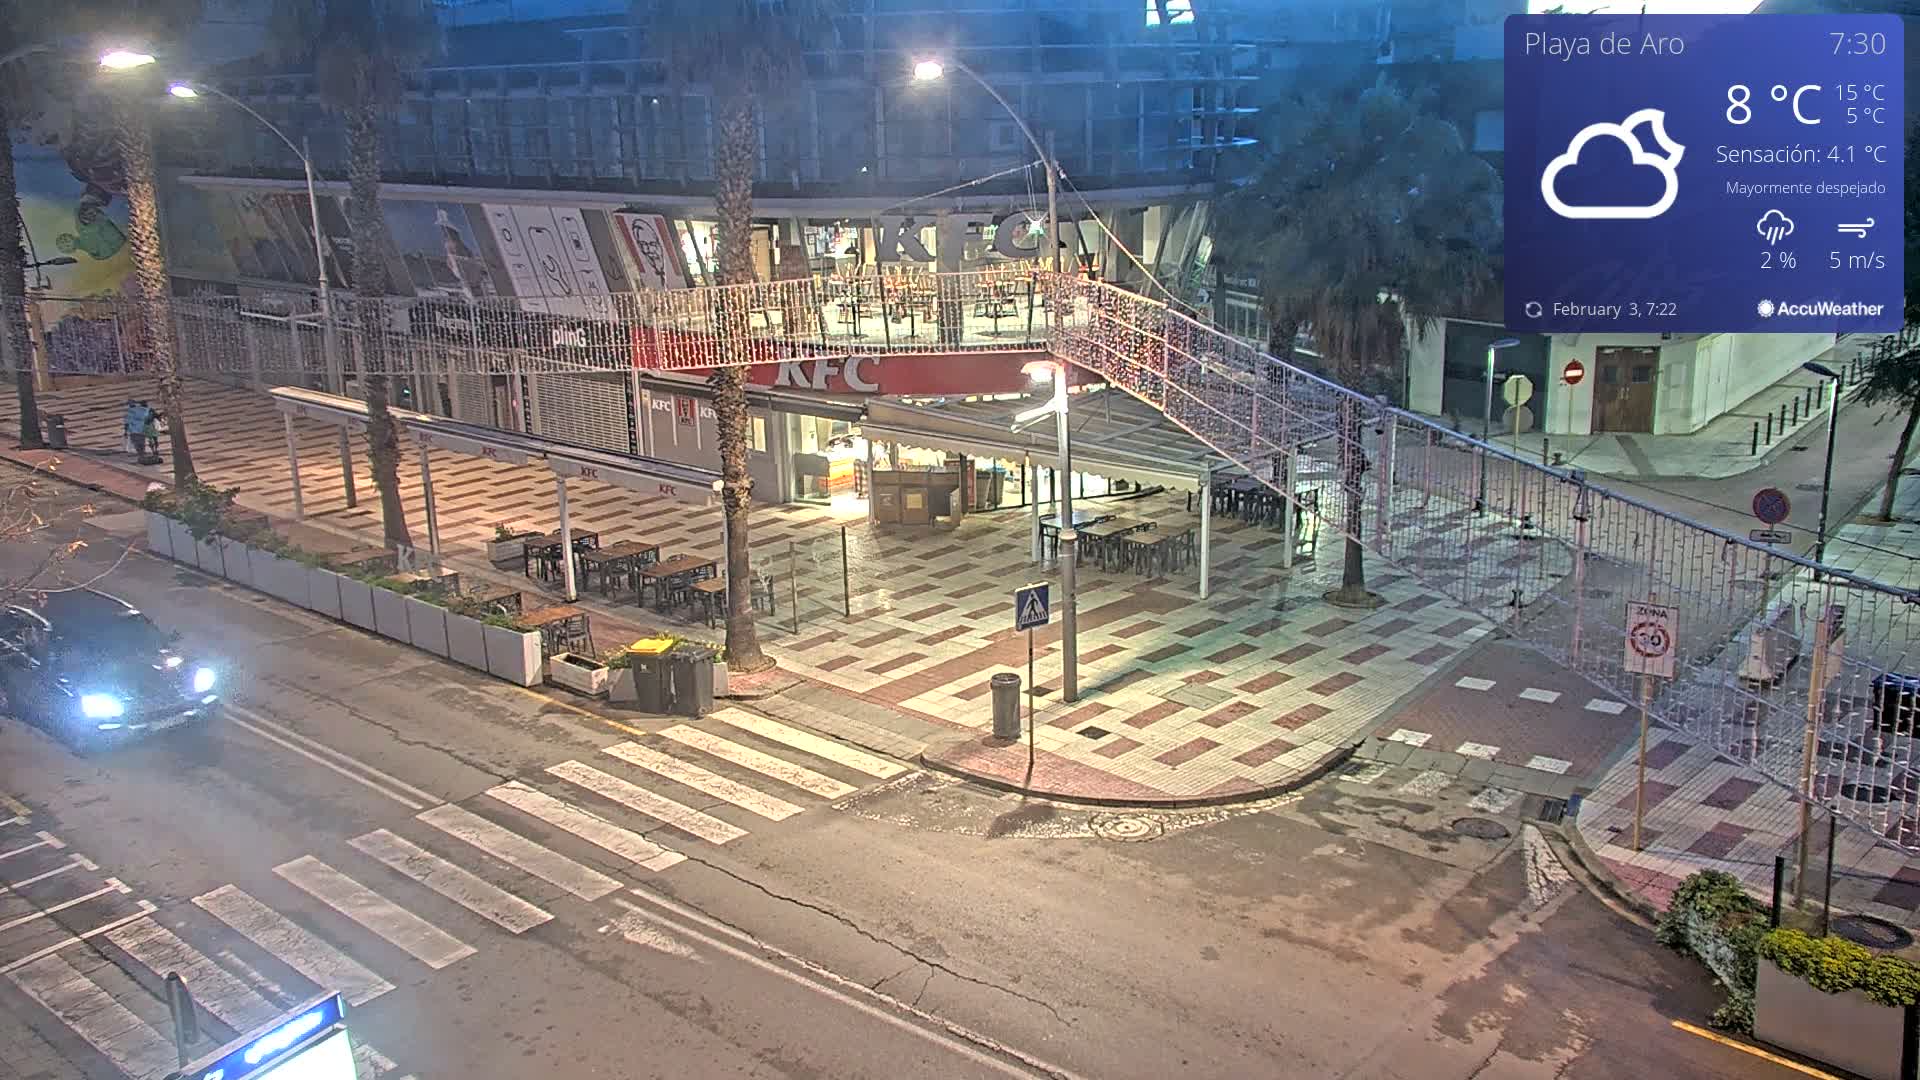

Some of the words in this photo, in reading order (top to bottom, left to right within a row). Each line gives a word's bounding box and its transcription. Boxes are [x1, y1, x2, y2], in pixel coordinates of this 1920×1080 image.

[876, 209, 1048, 264] KFC
[774, 355, 881, 393] KFC
[651, 399, 672, 412] KFC
[580, 466, 598, 479] KFC
[658, 484, 678, 497] KFC
